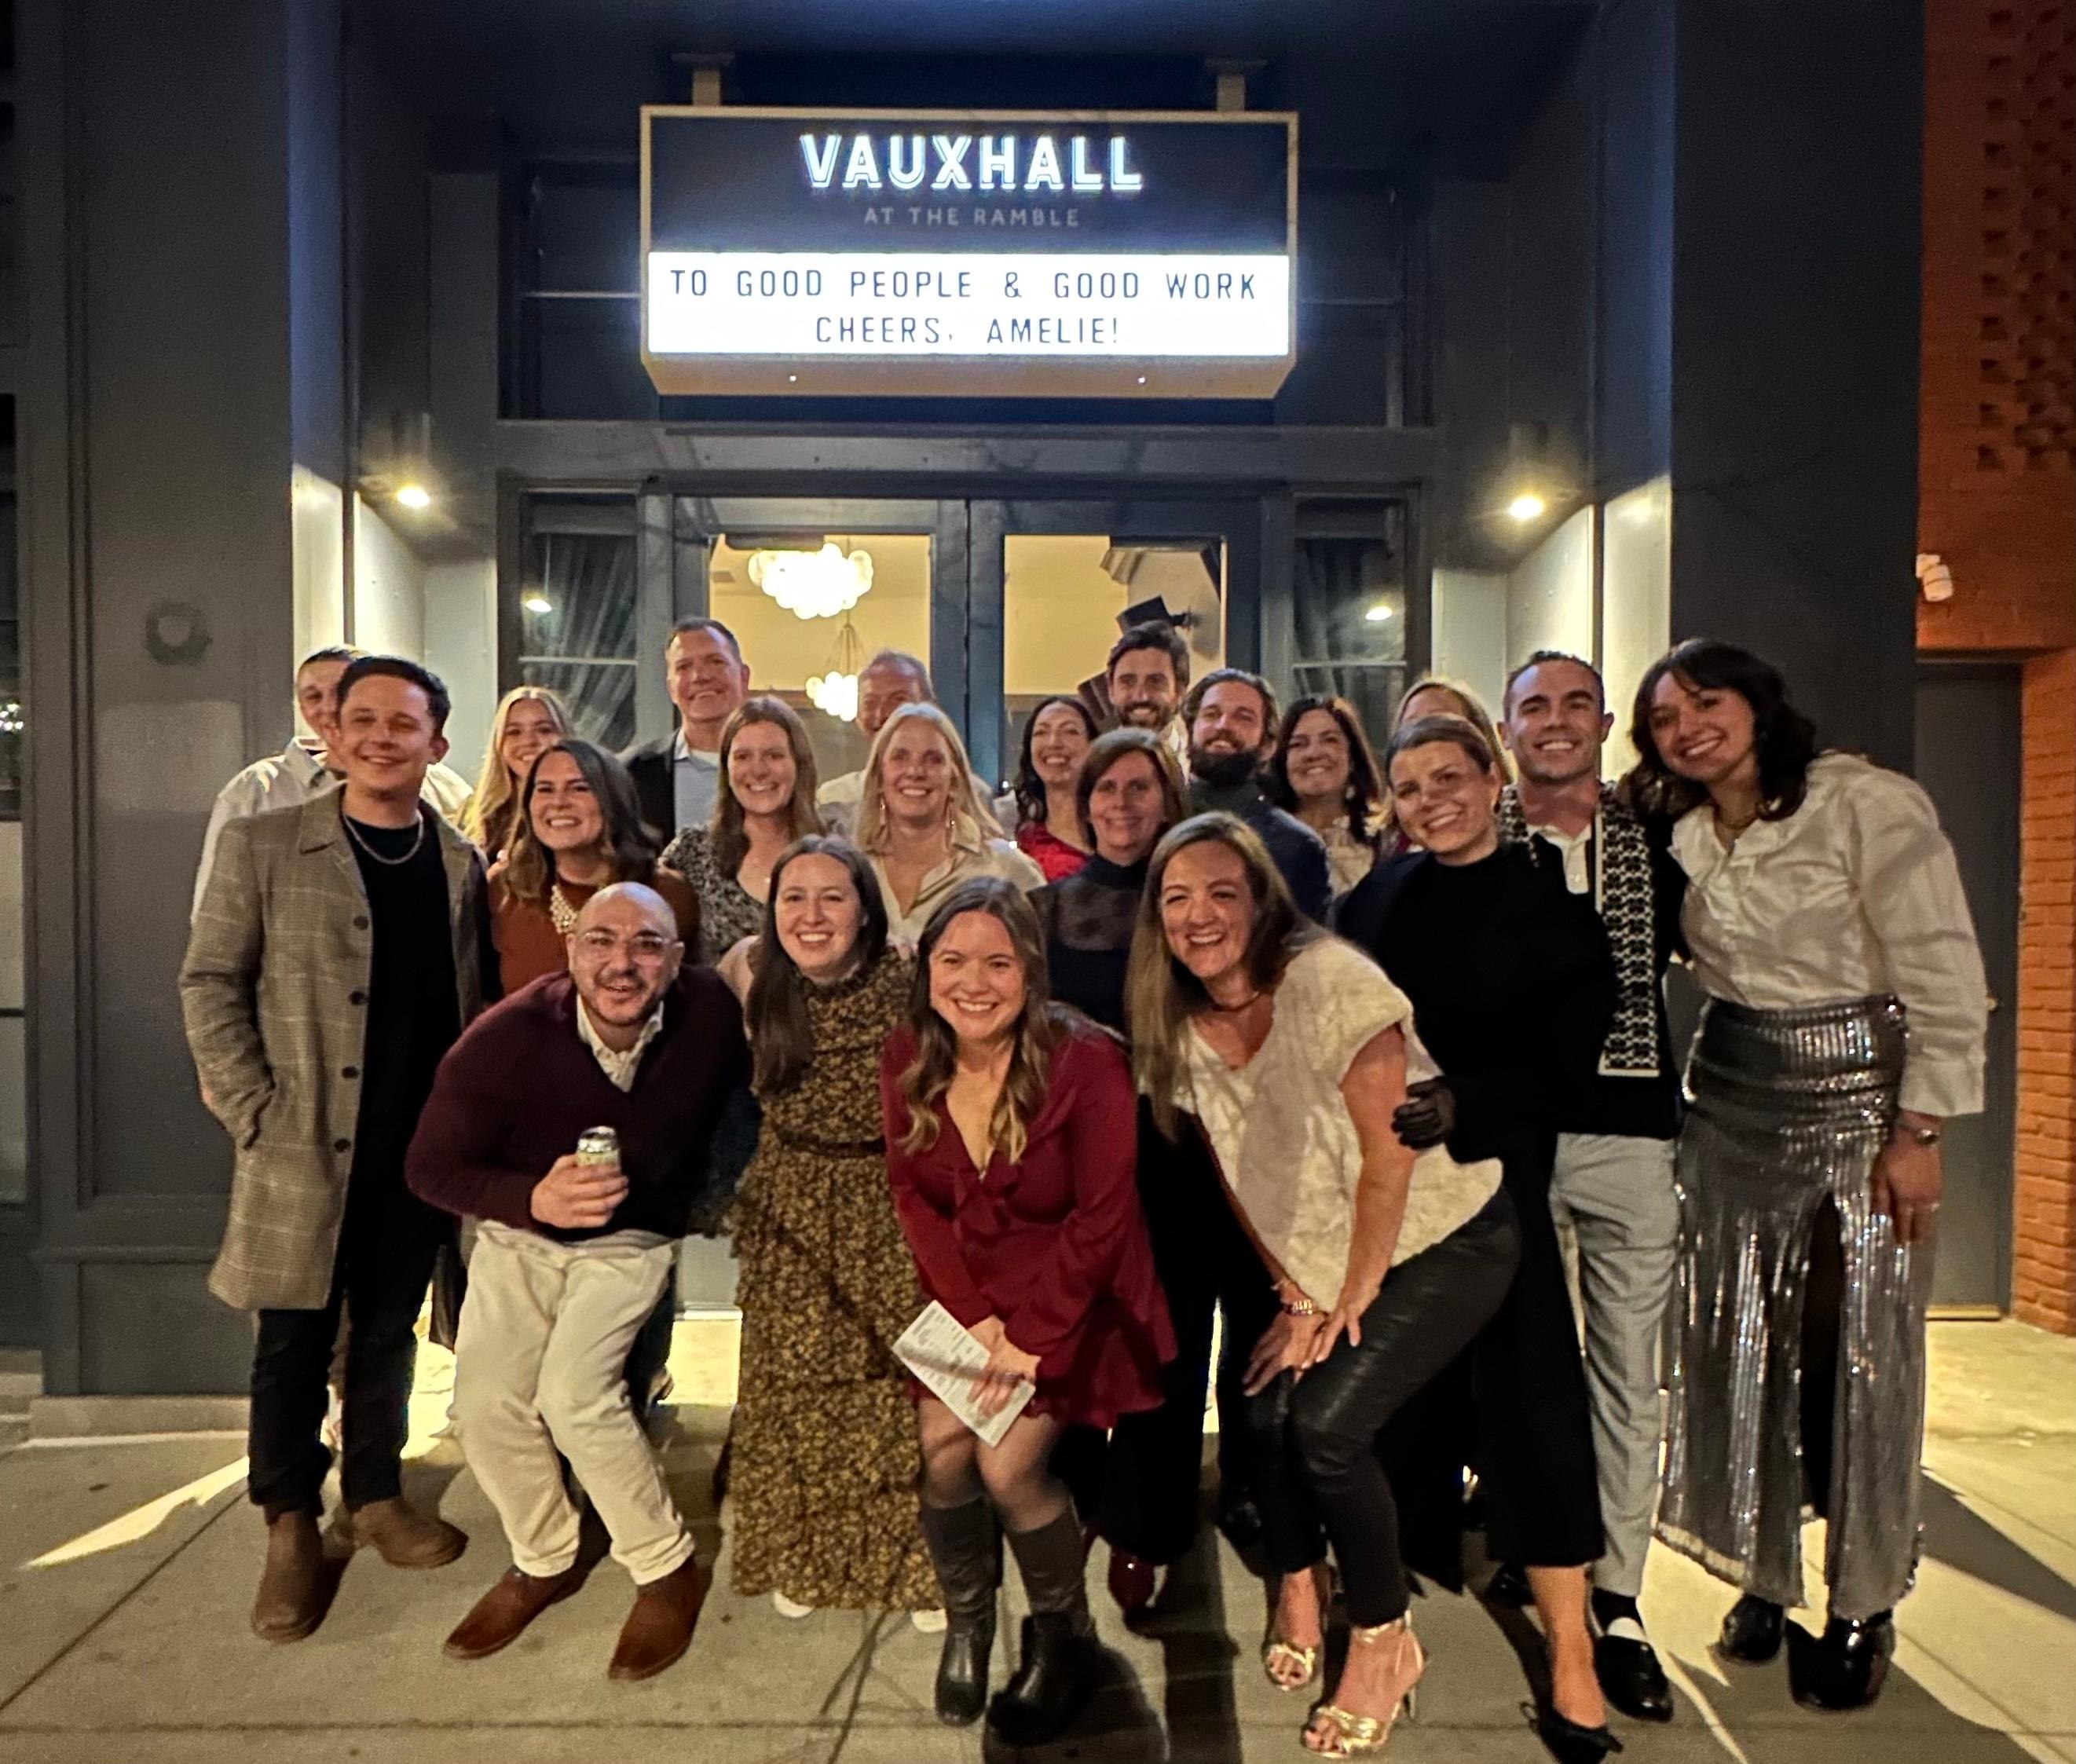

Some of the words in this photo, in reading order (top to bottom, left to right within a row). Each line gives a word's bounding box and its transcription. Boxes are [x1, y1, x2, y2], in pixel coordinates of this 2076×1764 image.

[799, 134, 1144, 192] VAUXHALL
[864, 207, 894, 225] AT
[909, 207, 960, 226] THE
[973, 208, 1078, 227] RAMBLE
[670, 269, 707, 296] TO
[737, 269, 822, 297] GOOD
[851, 271, 971, 298] PEOPLE
[1004, 272, 1022, 298] &
[1054, 272, 1138, 298] GOOD
[1166, 273, 1255, 299] WORK
[816, 317, 954, 343] CHEERS,
[987, 317, 1118, 344] AMELIE!
